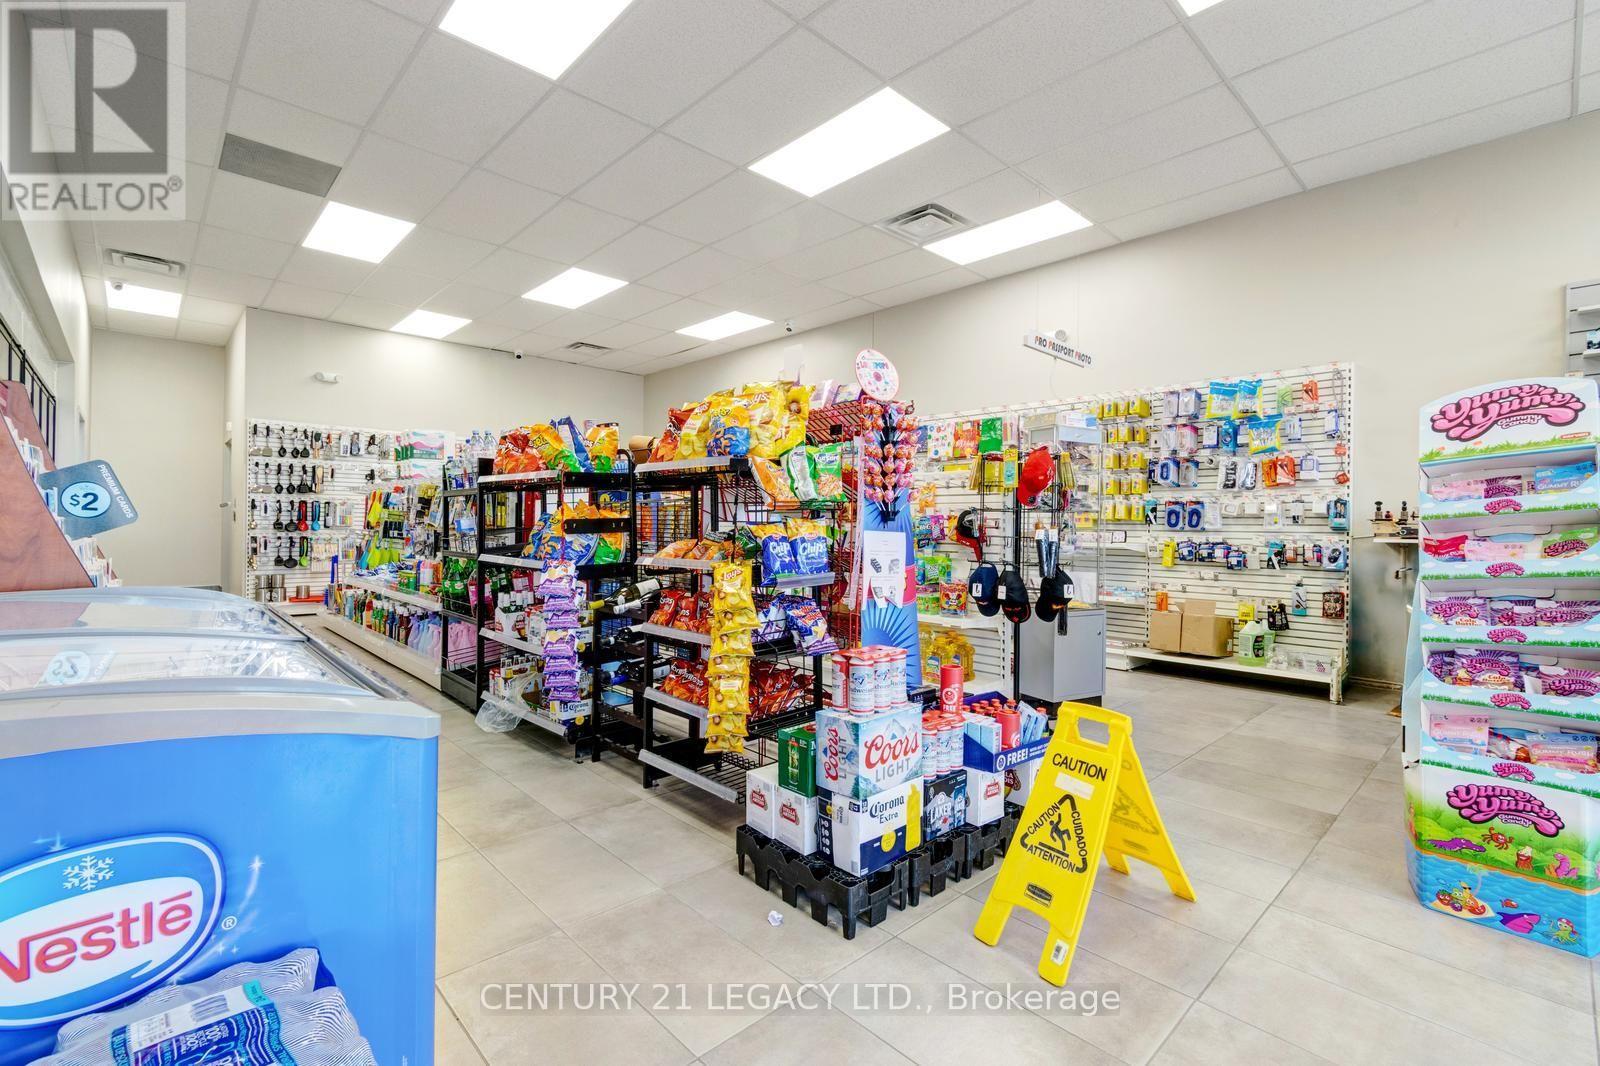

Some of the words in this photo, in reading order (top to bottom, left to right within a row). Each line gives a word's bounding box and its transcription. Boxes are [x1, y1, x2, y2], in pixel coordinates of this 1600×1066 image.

[1034, 335, 1048, 348] PRO
[1074, 350, 1092, 365] PHOTO
[69, 491, 100, 512] $2
[98, 464, 121, 496] PREMIUM
[116, 494, 135, 519] CARDS
[825, 726, 840, 782] Coors
[864, 729, 921, 770] Coors
[1007, 748, 1029, 766] FREE!
[875, 759, 911, 783] LIGHT
[1052, 753, 1108, 781] CAUTION
[869, 796, 905, 818] Corona
[879, 811, 899, 824] Extra
[1027, 802, 1061, 836] CAUTION
[1070, 811, 1088, 859] CUIDADO
[1027, 844, 1076, 873] ATTENTION
